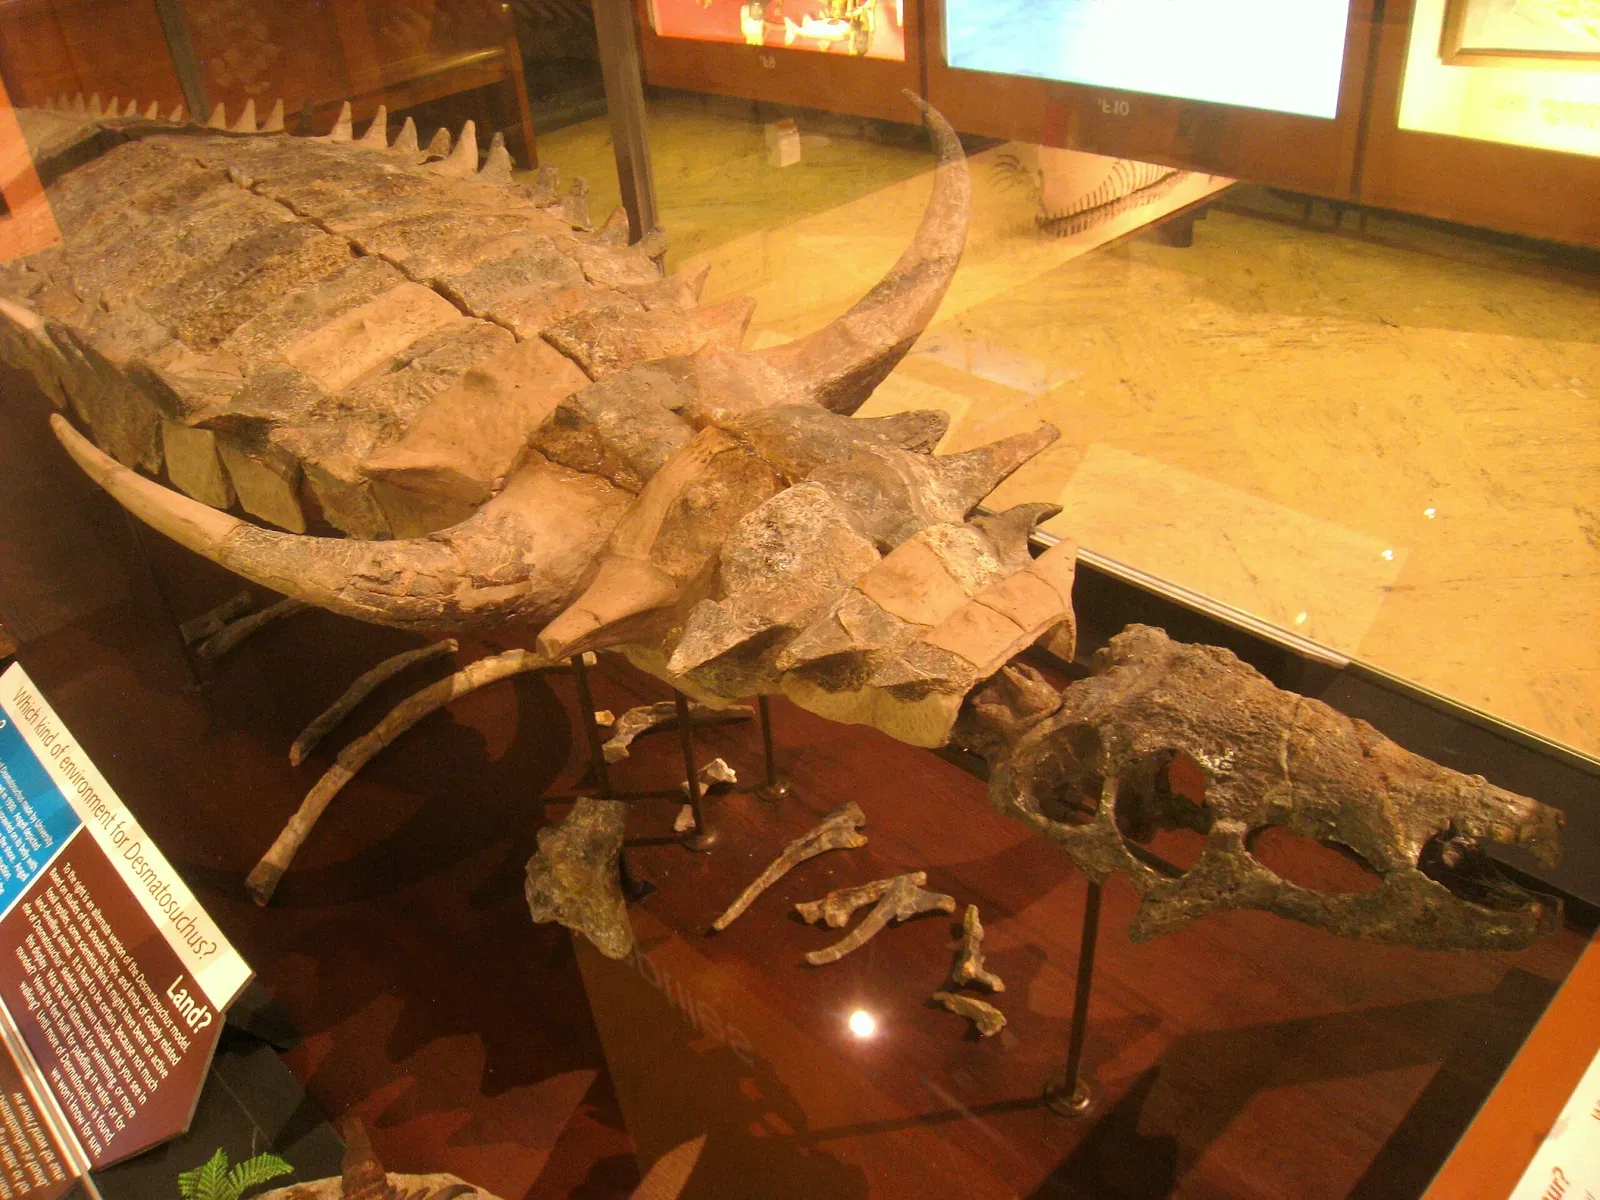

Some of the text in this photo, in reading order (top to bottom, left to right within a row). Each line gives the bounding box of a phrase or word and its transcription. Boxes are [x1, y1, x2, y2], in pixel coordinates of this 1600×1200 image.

[10, 685, 219, 964] Which kind of environment for Desmatosuchus?
[32, 818, 55, 849] University
[15, 942, 127, 1132] rounded? Were the feet built for paddling in water, or for
[21, 900, 149, 1106] else of Desmatosuchus' skeleton is known besides what you see in
[24, 932, 135, 1119] this display. Was the tail flattened for swimming, or more
[32, 894, 160, 1093] land-dwelling animal. It is hard to be certain, because not much
[44, 885, 170, 1080] fossil reptiles, some scientists think it might have been an active
[48, 866, 181, 1067] Based on studies of the shoulders, hips, and limbs of closely related
[61, 861, 192, 1054] To the right is an alternate version of the Desmatosuchus model.
[165, 972, 214, 1038] Land?
[16, 978, 116, 1147] walking? Until more of Desmatosuchus is found,
[50, 1067, 103, 1159] we won't know for sure.
